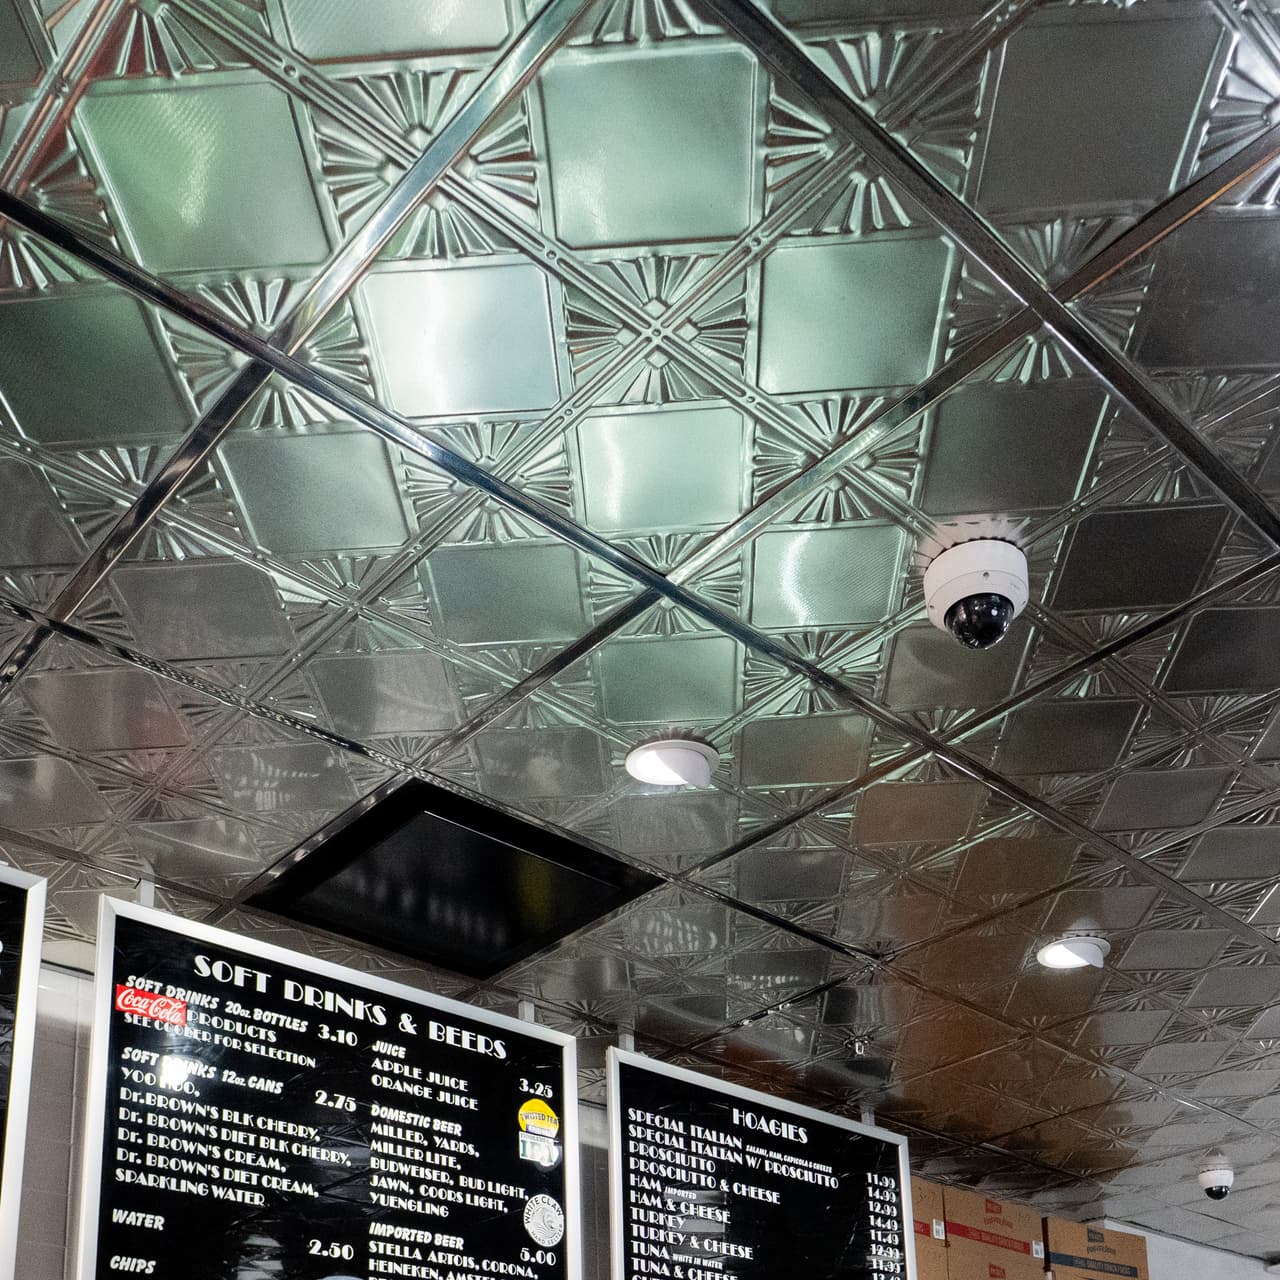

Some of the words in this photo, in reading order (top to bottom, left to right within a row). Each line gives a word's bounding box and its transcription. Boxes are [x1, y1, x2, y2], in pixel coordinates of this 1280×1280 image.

[116, 988, 186, 1025] Coca-Cola
[186, 1009, 278, 1044] PRODUCTS
[194, 955, 272, 994] SOFT
[283, 979, 387, 1027] DRINKS
[399, 1012, 417, 1035] &
[429, 1020, 507, 1060] BEERS
[371, 1040, 407, 1059] JUICE
[371, 1057, 423, 1080] APPLE
[426, 1071, 469, 1092] JUICE
[518, 1078, 553, 1099] 3.25
[371, 1074, 433, 1100] ORANGE
[435, 1088, 479, 1111] JUICE
[371, 1104, 431, 1129] DOMESTIC
[432, 1118, 462, 1137] BEER
[628, 1107, 688, 1135] SPECIAL
[690, 1124, 743, 1149] ITALIAN
[732, 1107, 808, 1144] HOAGIES
[629, 1140, 716, 1174] PROSCIUTTO
[370, 1157, 454, 1186] BUDWEISER,
[459, 1174, 486, 1191] BUD
[487, 1181, 529, 1201] LIGHT,
[629, 1156, 717, 1190] PROSCIUTTO
[720, 1178, 730, 1193] &
[732, 1181, 781, 1205] CHEESE
[866, 1172, 896, 1190] 11.99
[370, 1192, 449, 1218] YUENGLING
[525, 1197, 540, 1224] WHITE
[541, 1196, 563, 1216] CLAW
[630, 1206, 686, 1229] TURKEY
[868, 1200, 898, 1218] 12.99
[112, 1208, 165, 1231] WATER
[869, 1215, 898, 1232] 14.49
[307, 1239, 355, 1261] 2.50
[369, 1222, 433, 1244] IMPORTED
[434, 1232, 464, 1251] BEER
[110, 1255, 156, 1274] CHIPS
[369, 1240, 423, 1261] STELLA
[427, 1250, 480, 1271] ARTOIS,
[482, 1259, 539, 1280] CORONA,
[520, 1248, 557, 1266] 5.00
[631, 1258, 670, 1276] TUNA
[674, 1265, 684, 1279] &
